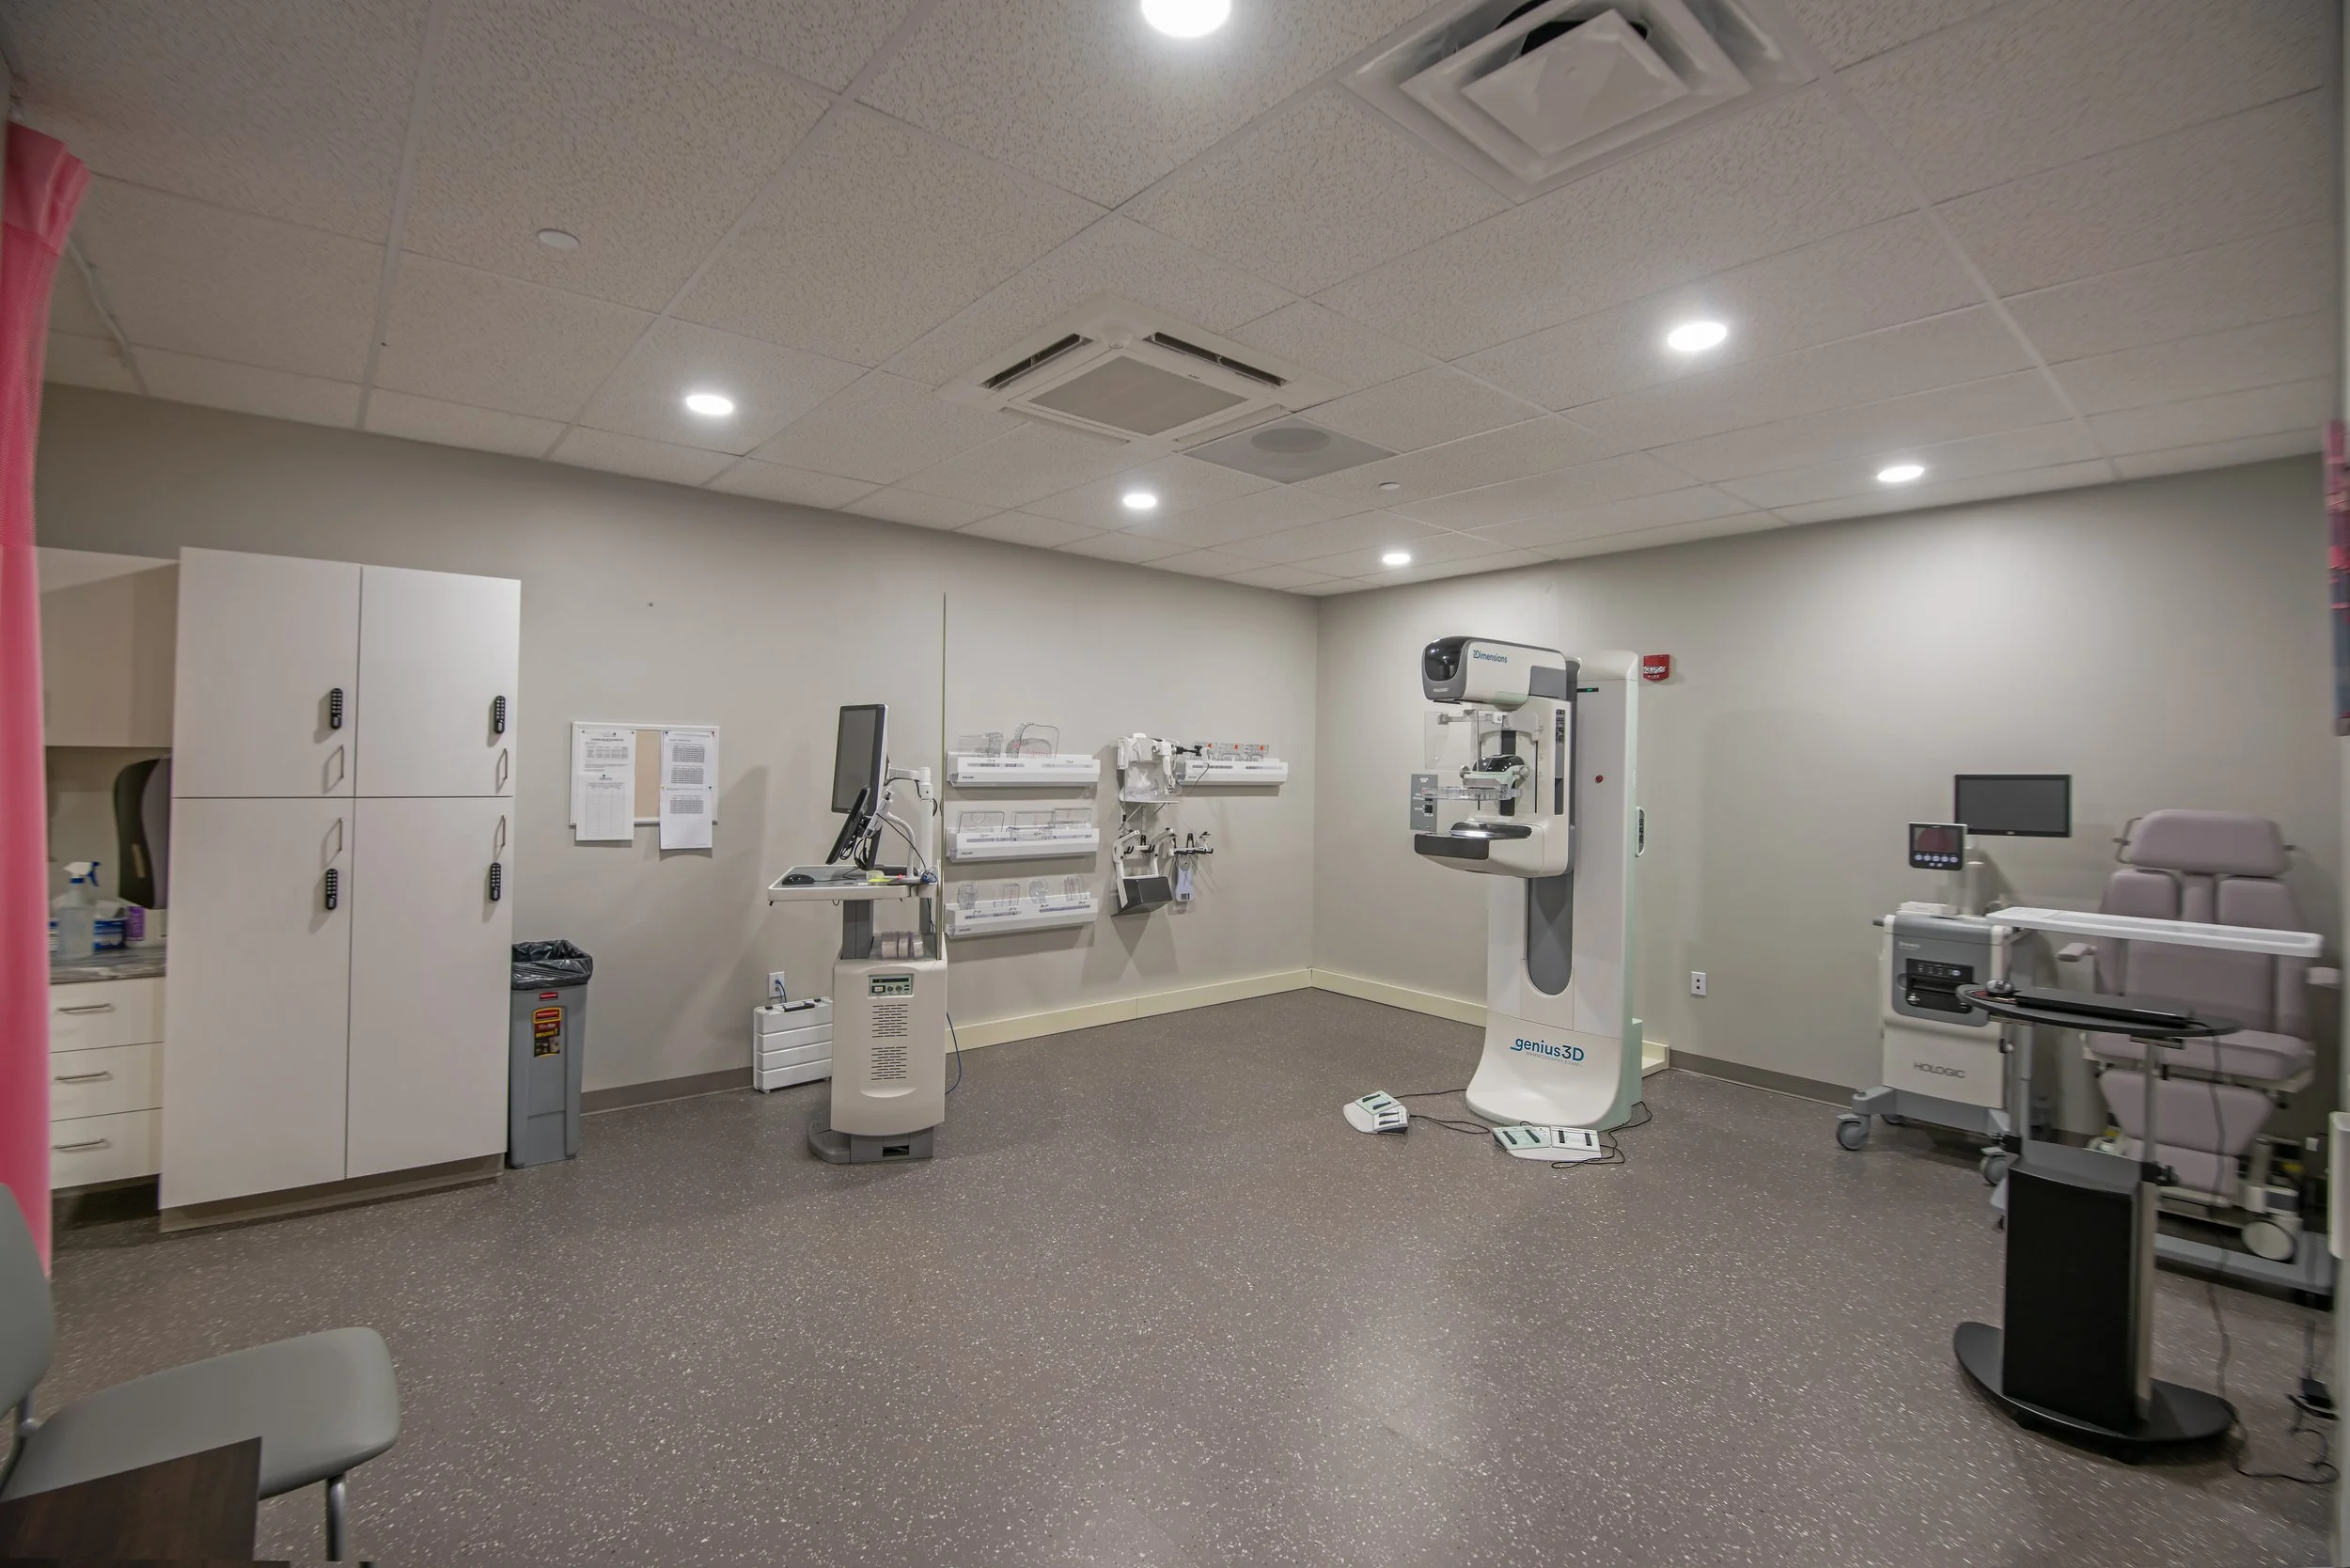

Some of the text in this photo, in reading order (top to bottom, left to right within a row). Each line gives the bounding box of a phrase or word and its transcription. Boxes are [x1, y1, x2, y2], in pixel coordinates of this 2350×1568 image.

[1473, 650, 1508, 663] 3Dimensions
[1510, 1038, 1585, 1061] genius3D
[1913, 1061, 1966, 1078] HOLOGIC
